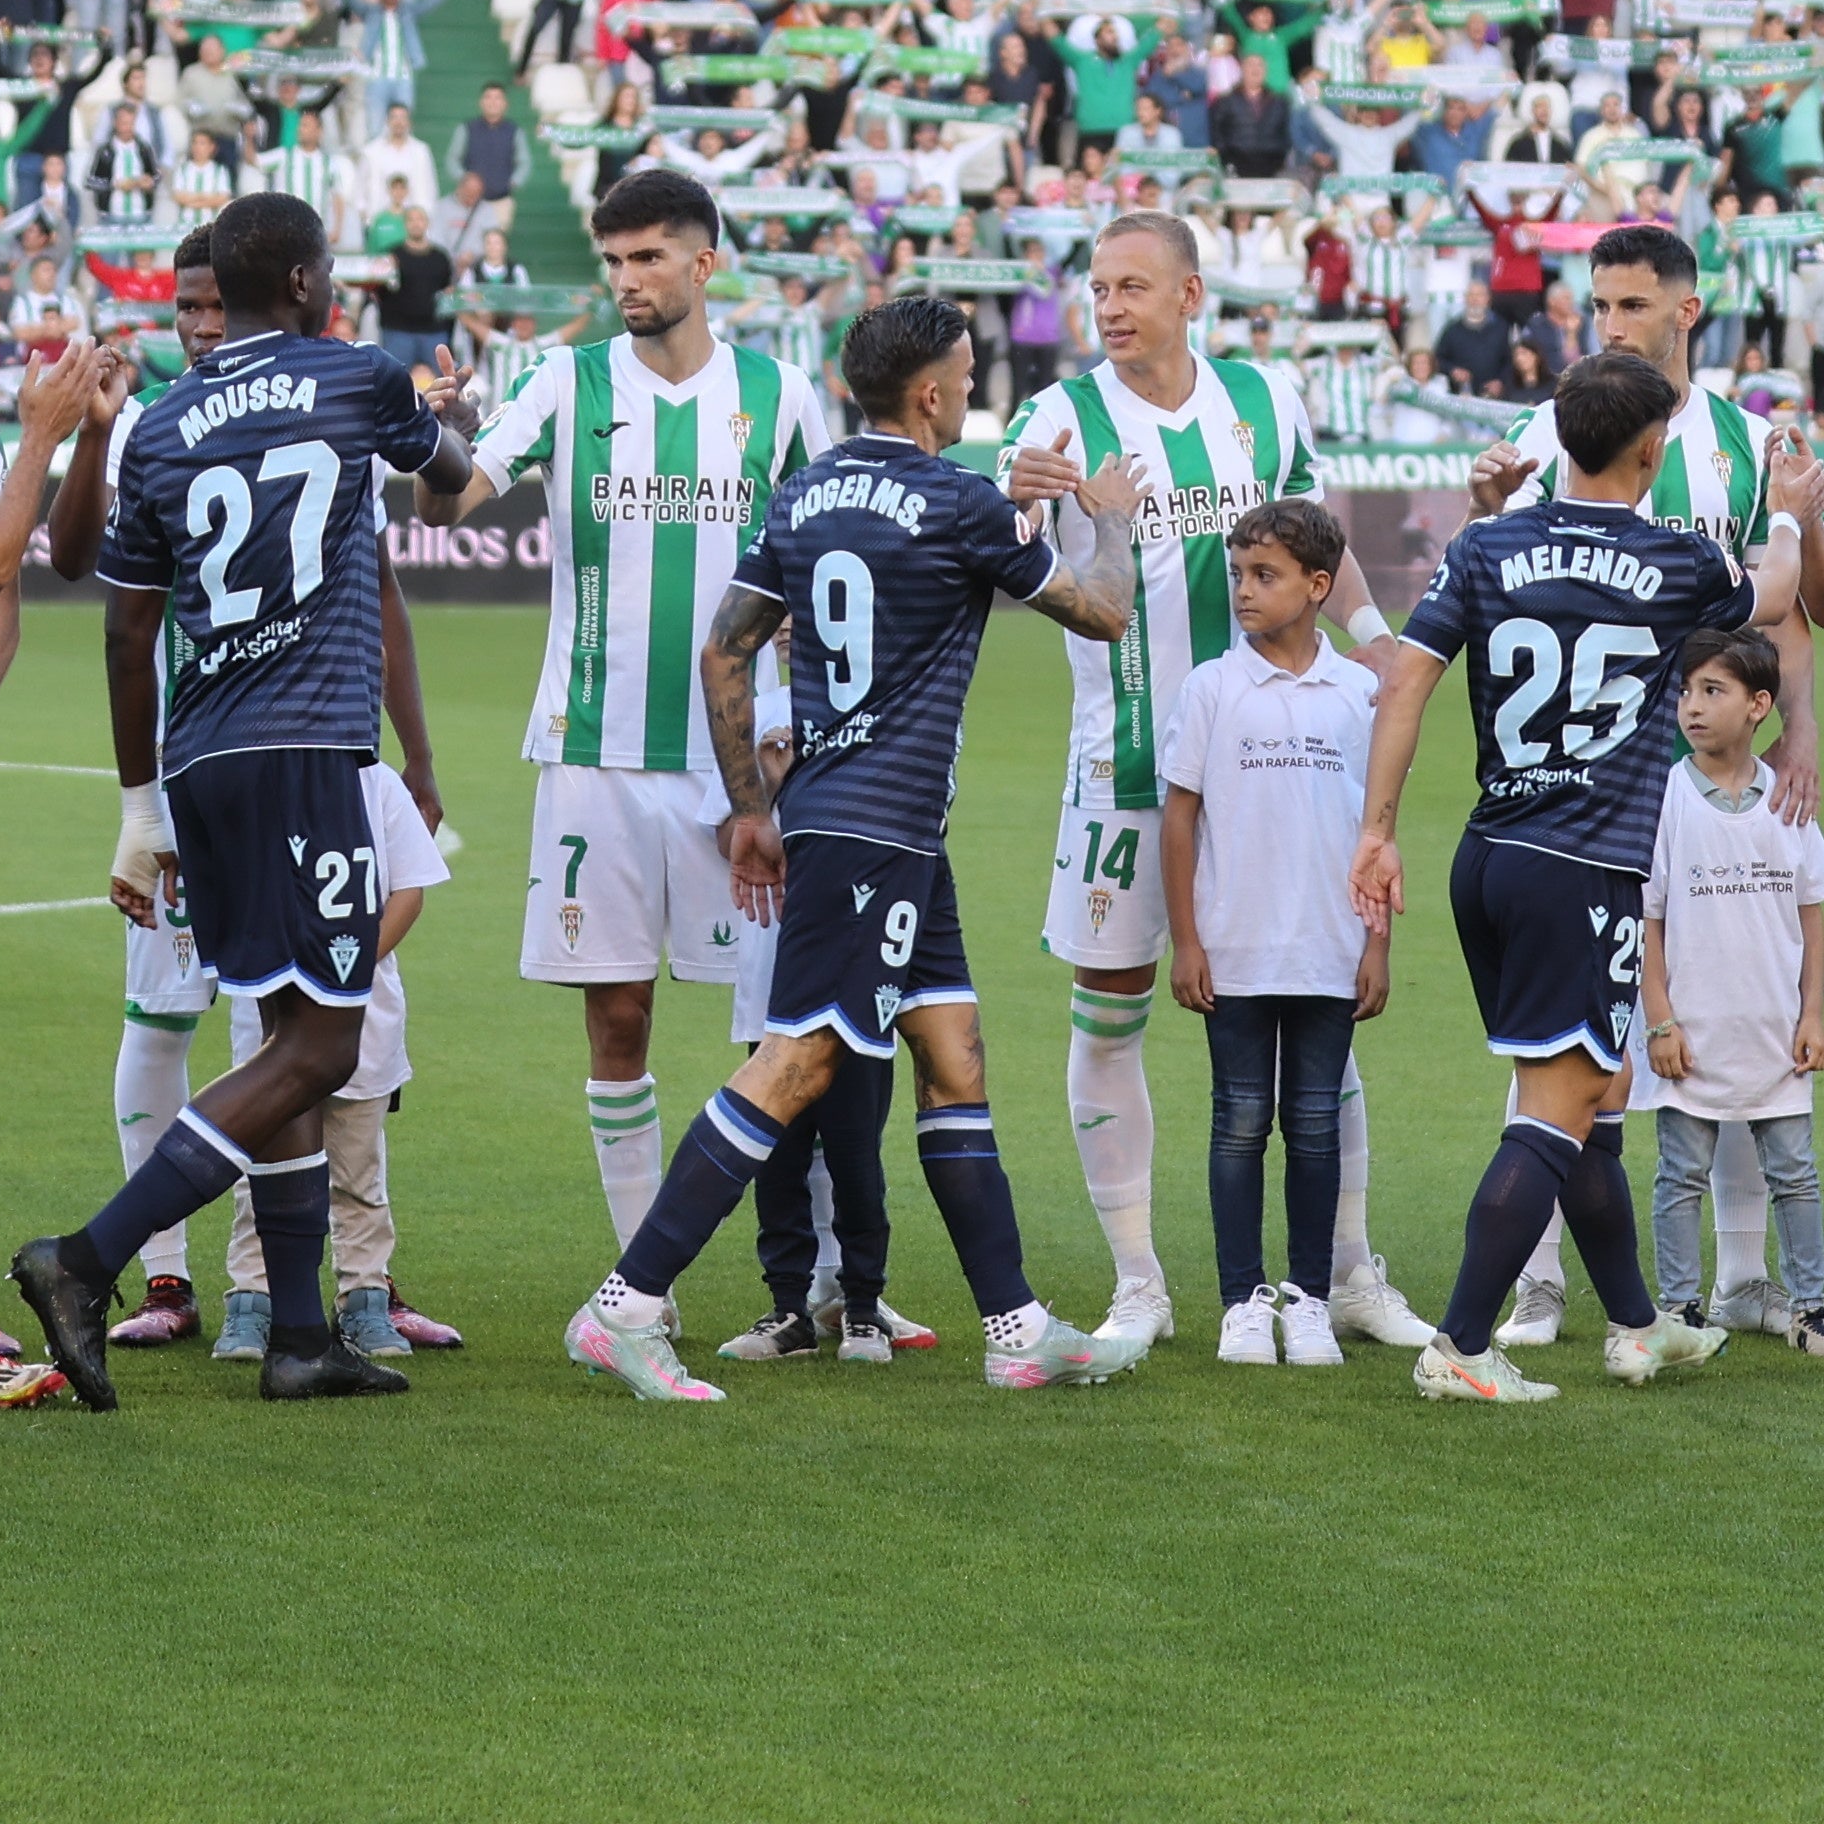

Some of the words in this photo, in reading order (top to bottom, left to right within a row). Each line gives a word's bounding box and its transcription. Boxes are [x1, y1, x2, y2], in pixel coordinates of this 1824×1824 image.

[177, 373, 318, 450] MOUSSA
[591, 474, 755, 505] BAHRAIN
[592, 502, 752, 525] VICTORIOUS
[1139, 480, 1268, 522] AHRAIN
[186, 439, 342, 629] 27
[1499, 544, 1663, 601] MELENDO
[580, 574, 591, 649] PATRIMONIO
[590, 564, 601, 650] HUMANIDAD
[811, 550, 875, 713] 9
[581, 654, 593, 705] CÓRDOBA
[1489, 617, 1660, 770] 25
[1131, 698, 1143, 749] CÓRDOBA
[1240, 758, 1265, 771] SAN
[1266, 757, 1312, 769] RAFAEL
[314, 846, 377, 920] 27
[559, 834, 589, 899] 7
[1082, 820, 1141, 891] 14
[1689, 884, 1714, 897] SAN
[1716, 882, 1758, 896] RAFAEL
[1760, 880, 1794, 894] MOTOR
[880, 900, 919, 968] 9
